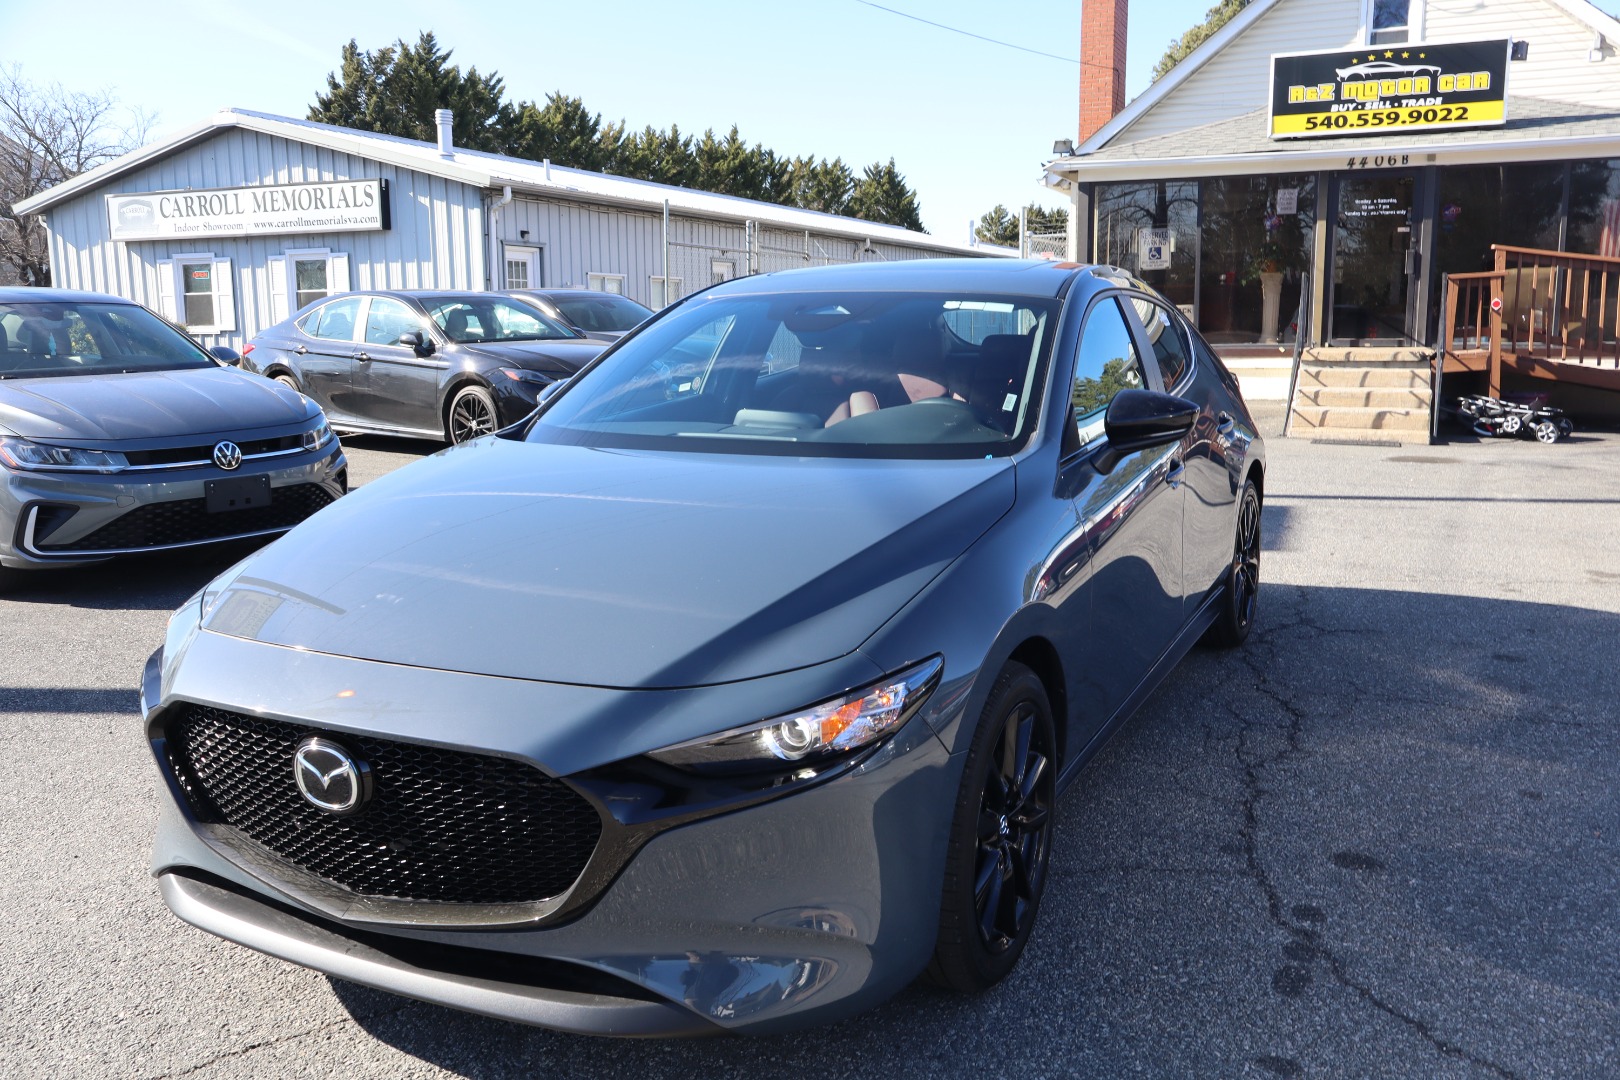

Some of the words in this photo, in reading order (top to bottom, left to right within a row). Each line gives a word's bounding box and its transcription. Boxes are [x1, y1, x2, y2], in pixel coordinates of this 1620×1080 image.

[1331, 103, 1357, 112] BUY
[1364, 101, 1391, 110] SELL
[1401, 97, 1443, 108] TRADE
[1305, 107, 1469, 130] 540.559.9022
[160, 193, 245, 219] CARROLL
[251, 184, 374, 214] MEMORIALS
[174, 223, 200, 232] Indoor
[203, 221, 244, 232] Showroom
[253, 215, 378, 228] www.carrollmemorialsva.com
